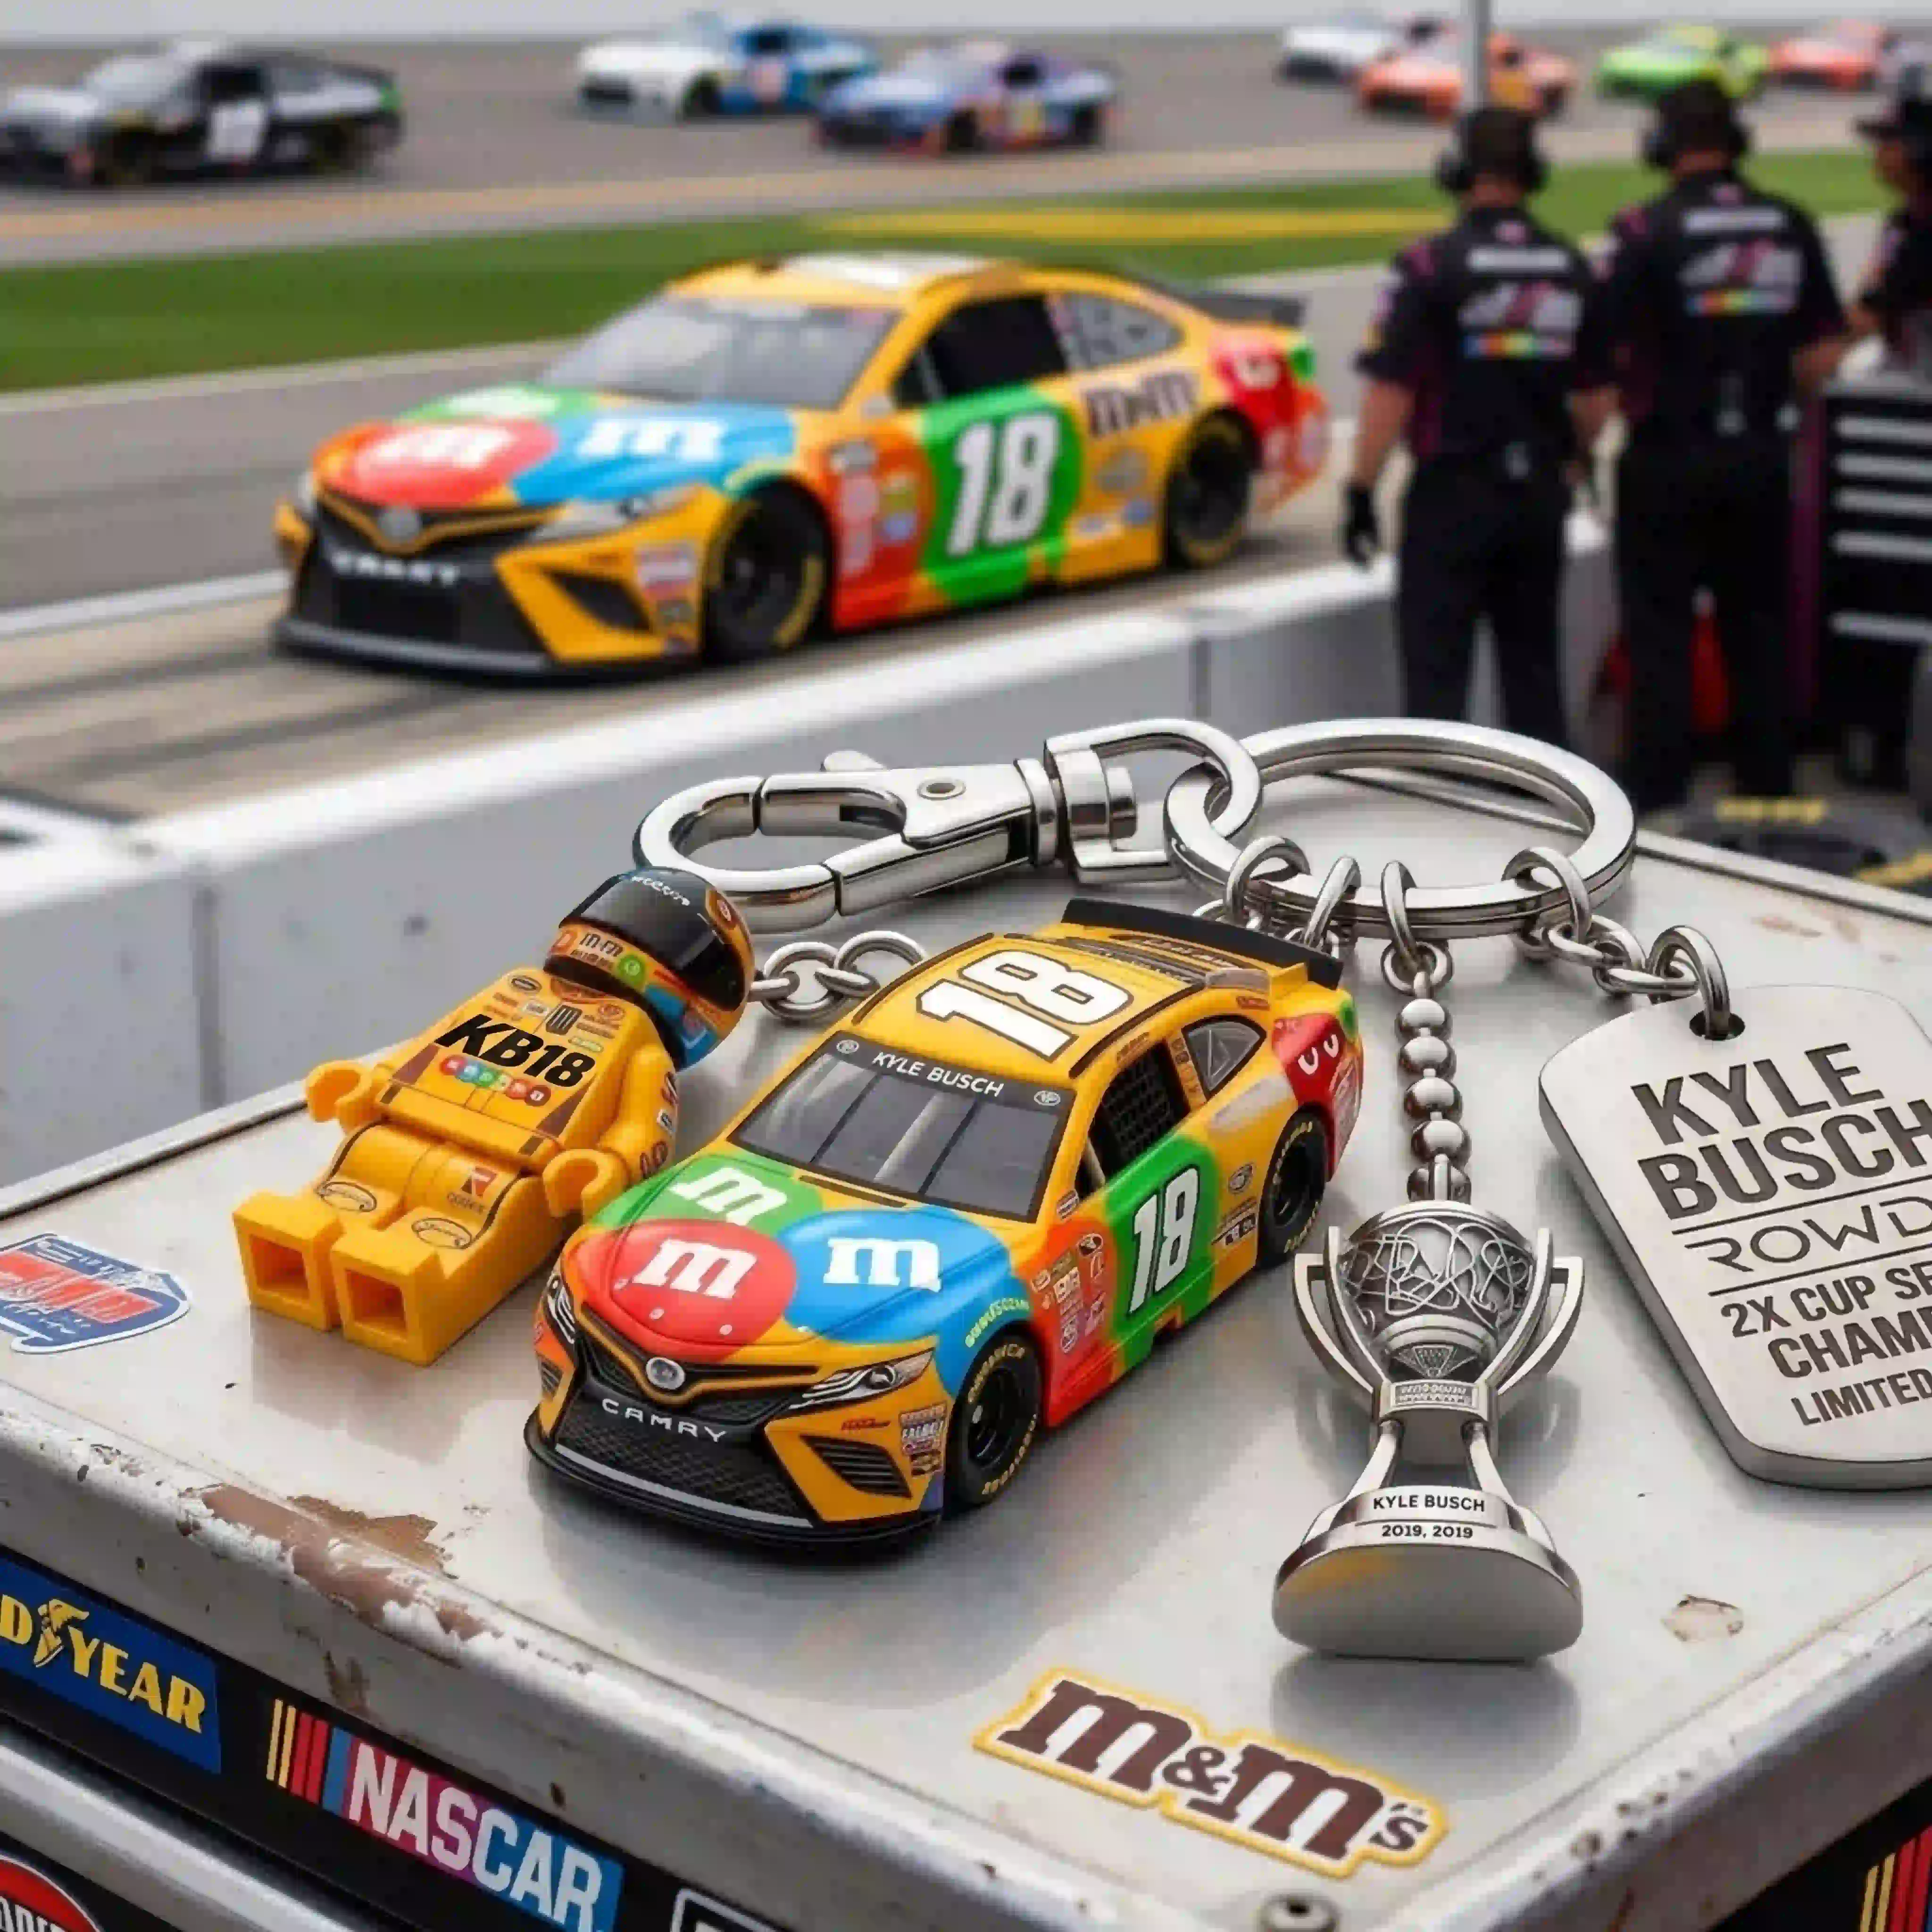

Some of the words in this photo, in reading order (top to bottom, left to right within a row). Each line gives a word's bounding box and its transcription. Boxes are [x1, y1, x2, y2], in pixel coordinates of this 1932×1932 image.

[947, 412, 1059, 556] 18
[916, 949, 1133, 1061] 18
[434, 1014, 595, 1087] KB18
[873, 1052, 925, 1076] KYLE
[926, 1066, 1004, 1097] BUSCH
[1630, 1043, 1883, 1145] KYLE
[1638, 1099, 1932, 1220] BUSCH
[668, 1167, 787, 1225] m
[824, 1237, 941, 1291] m
[1130, 1167, 1199, 1314] 18
[1685, 1197, 1932, 1272] ROWD
[634, 1239, 757, 1299] m
[1721, 1297, 1790, 1338] 2X
[1790, 1275, 1875, 1321] CUP
[602, 1399, 727, 1443] CAMRY
[1790, 1368, 1932, 1426] LIMITED
[1373, 1494, 1418, 1510] KYLE
[1424, 1494, 1485, 1512] BUSCH
[1382, 1524, 1427, 1539] 2019,
[1432, 1525, 1473, 1540] 2019
[349, 1742, 603, 1932] NASCAR
